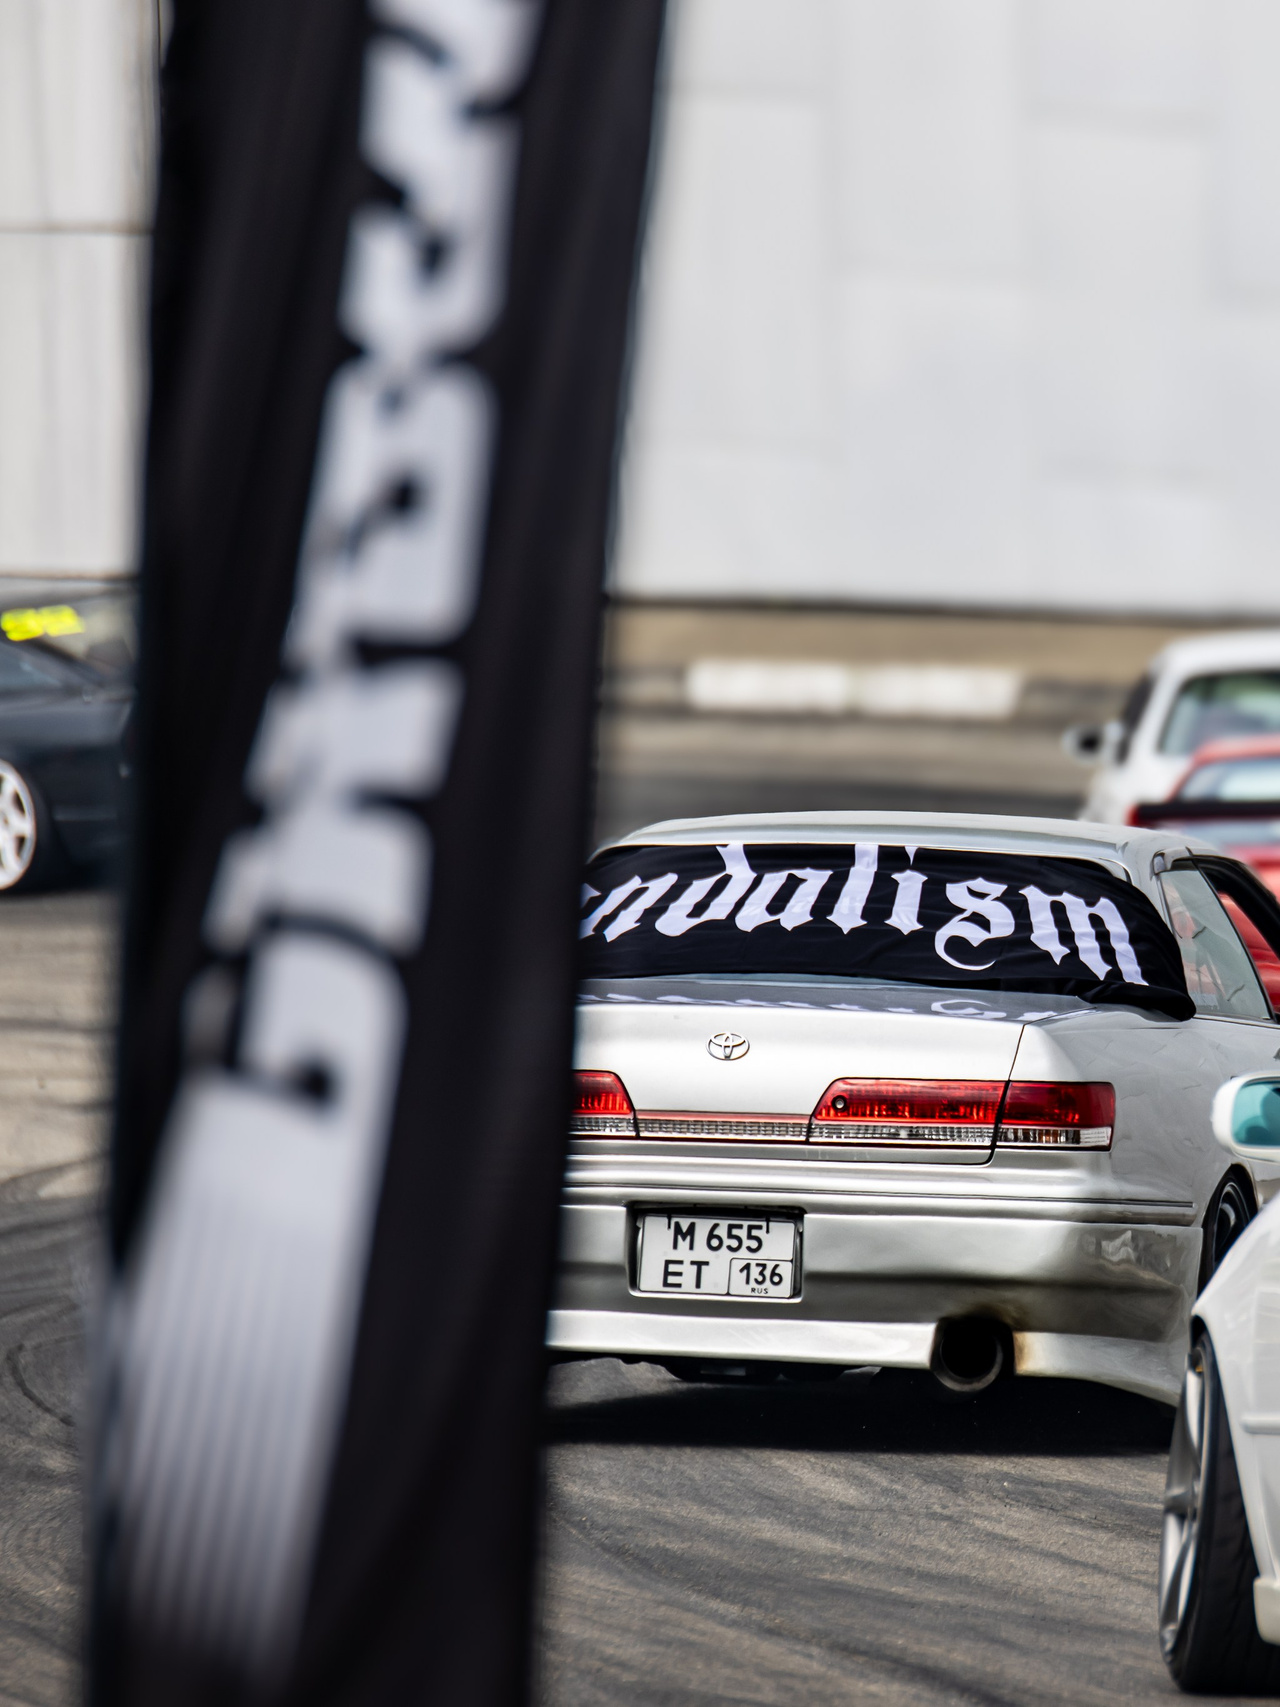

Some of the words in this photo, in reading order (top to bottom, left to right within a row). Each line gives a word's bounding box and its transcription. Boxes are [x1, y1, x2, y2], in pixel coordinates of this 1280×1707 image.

[577, 843, 1150, 987] ndalism
[672, 1220, 696, 1250] M
[706, 1222, 764, 1253] 655
[662, 1259, 710, 1289] ET
[739, 1262, 783, 1286] 136
[750, 1287, 769, 1295] RUS
